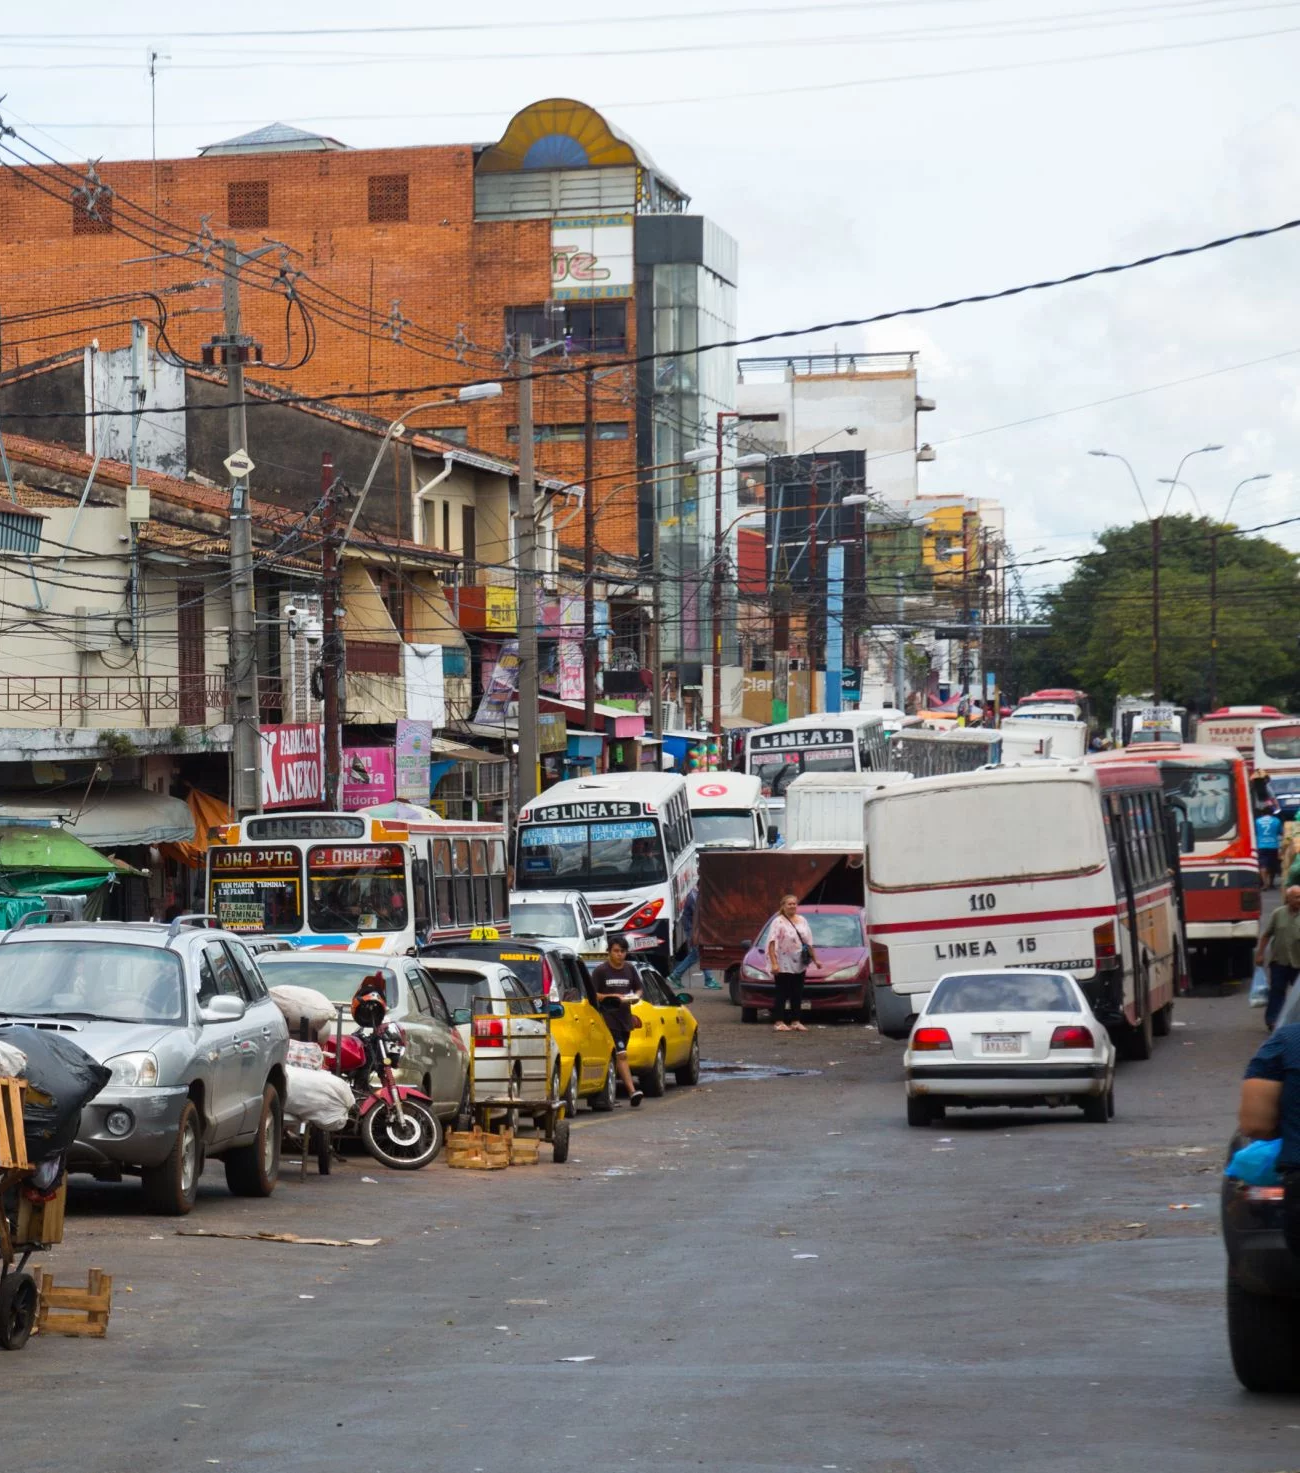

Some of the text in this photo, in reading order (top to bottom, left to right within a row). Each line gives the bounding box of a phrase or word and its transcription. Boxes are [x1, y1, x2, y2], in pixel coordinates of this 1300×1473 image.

[280, 727, 317, 756] FARMACIA
[825, 731, 844, 743] 13
[540, 803, 631, 820] 13 LINEA 13
[1262, 825, 1272, 835] 2
[221, 881, 232, 889] SAN
[233, 881, 255, 889] MARTIN
[1209, 873, 1229, 887] 71
[968, 893, 997, 912] 110
[221, 910, 261, 918] TERMINAL
[475, 929, 496, 939] TAXI
[934, 937, 1037, 961] LINEA 15
